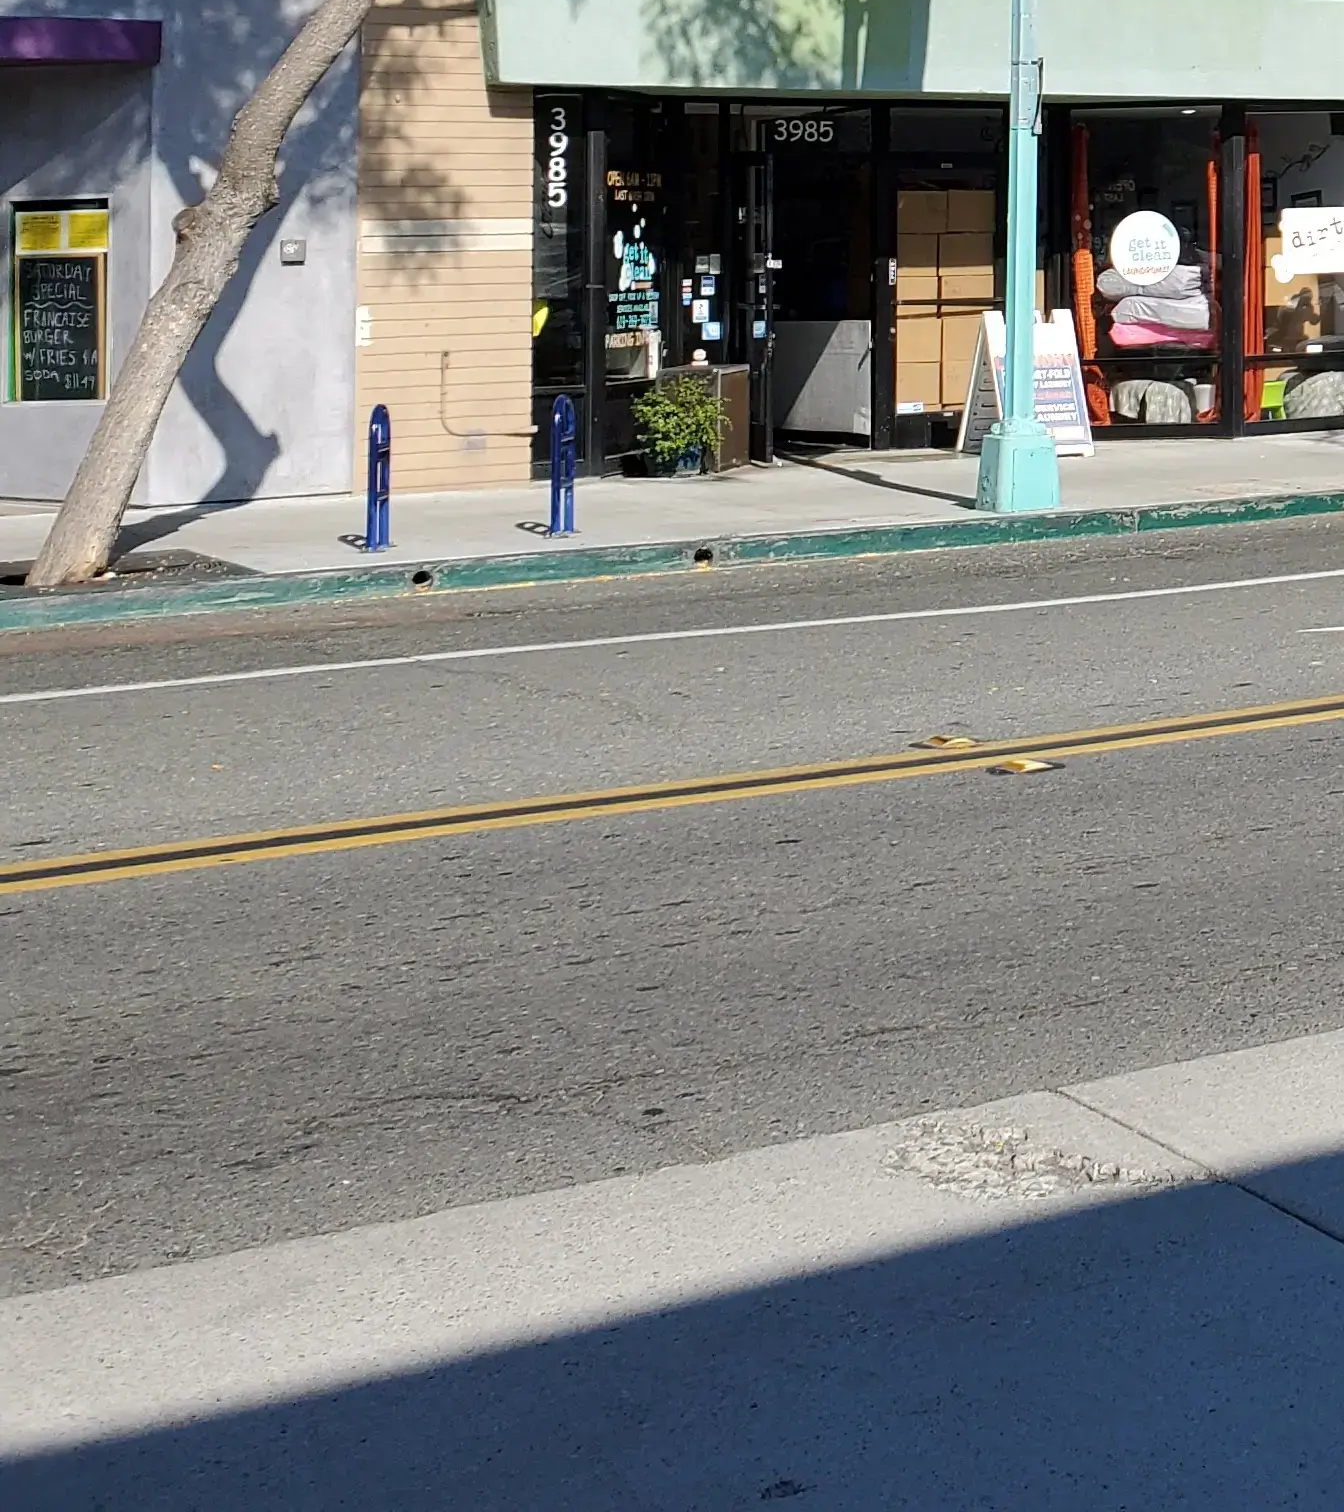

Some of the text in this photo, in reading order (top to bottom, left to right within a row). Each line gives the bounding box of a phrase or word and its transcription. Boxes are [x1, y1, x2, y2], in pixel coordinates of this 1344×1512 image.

[774, 119, 834, 143] 3985
[548, 107, 569, 208] 3985
[1128, 237, 1167, 252] get it
[624, 243, 639, 265] get
[1132, 250, 1172, 262] clean
[32, 283, 87, 301] SPECIAL
[24, 309, 91, 328] FRANCAISE
[23, 329, 73, 345] BURGER
[39, 349, 77, 366] FRIES
[25, 369, 60, 383] SODA
[1037, 412, 1077, 422] AUNDRY
